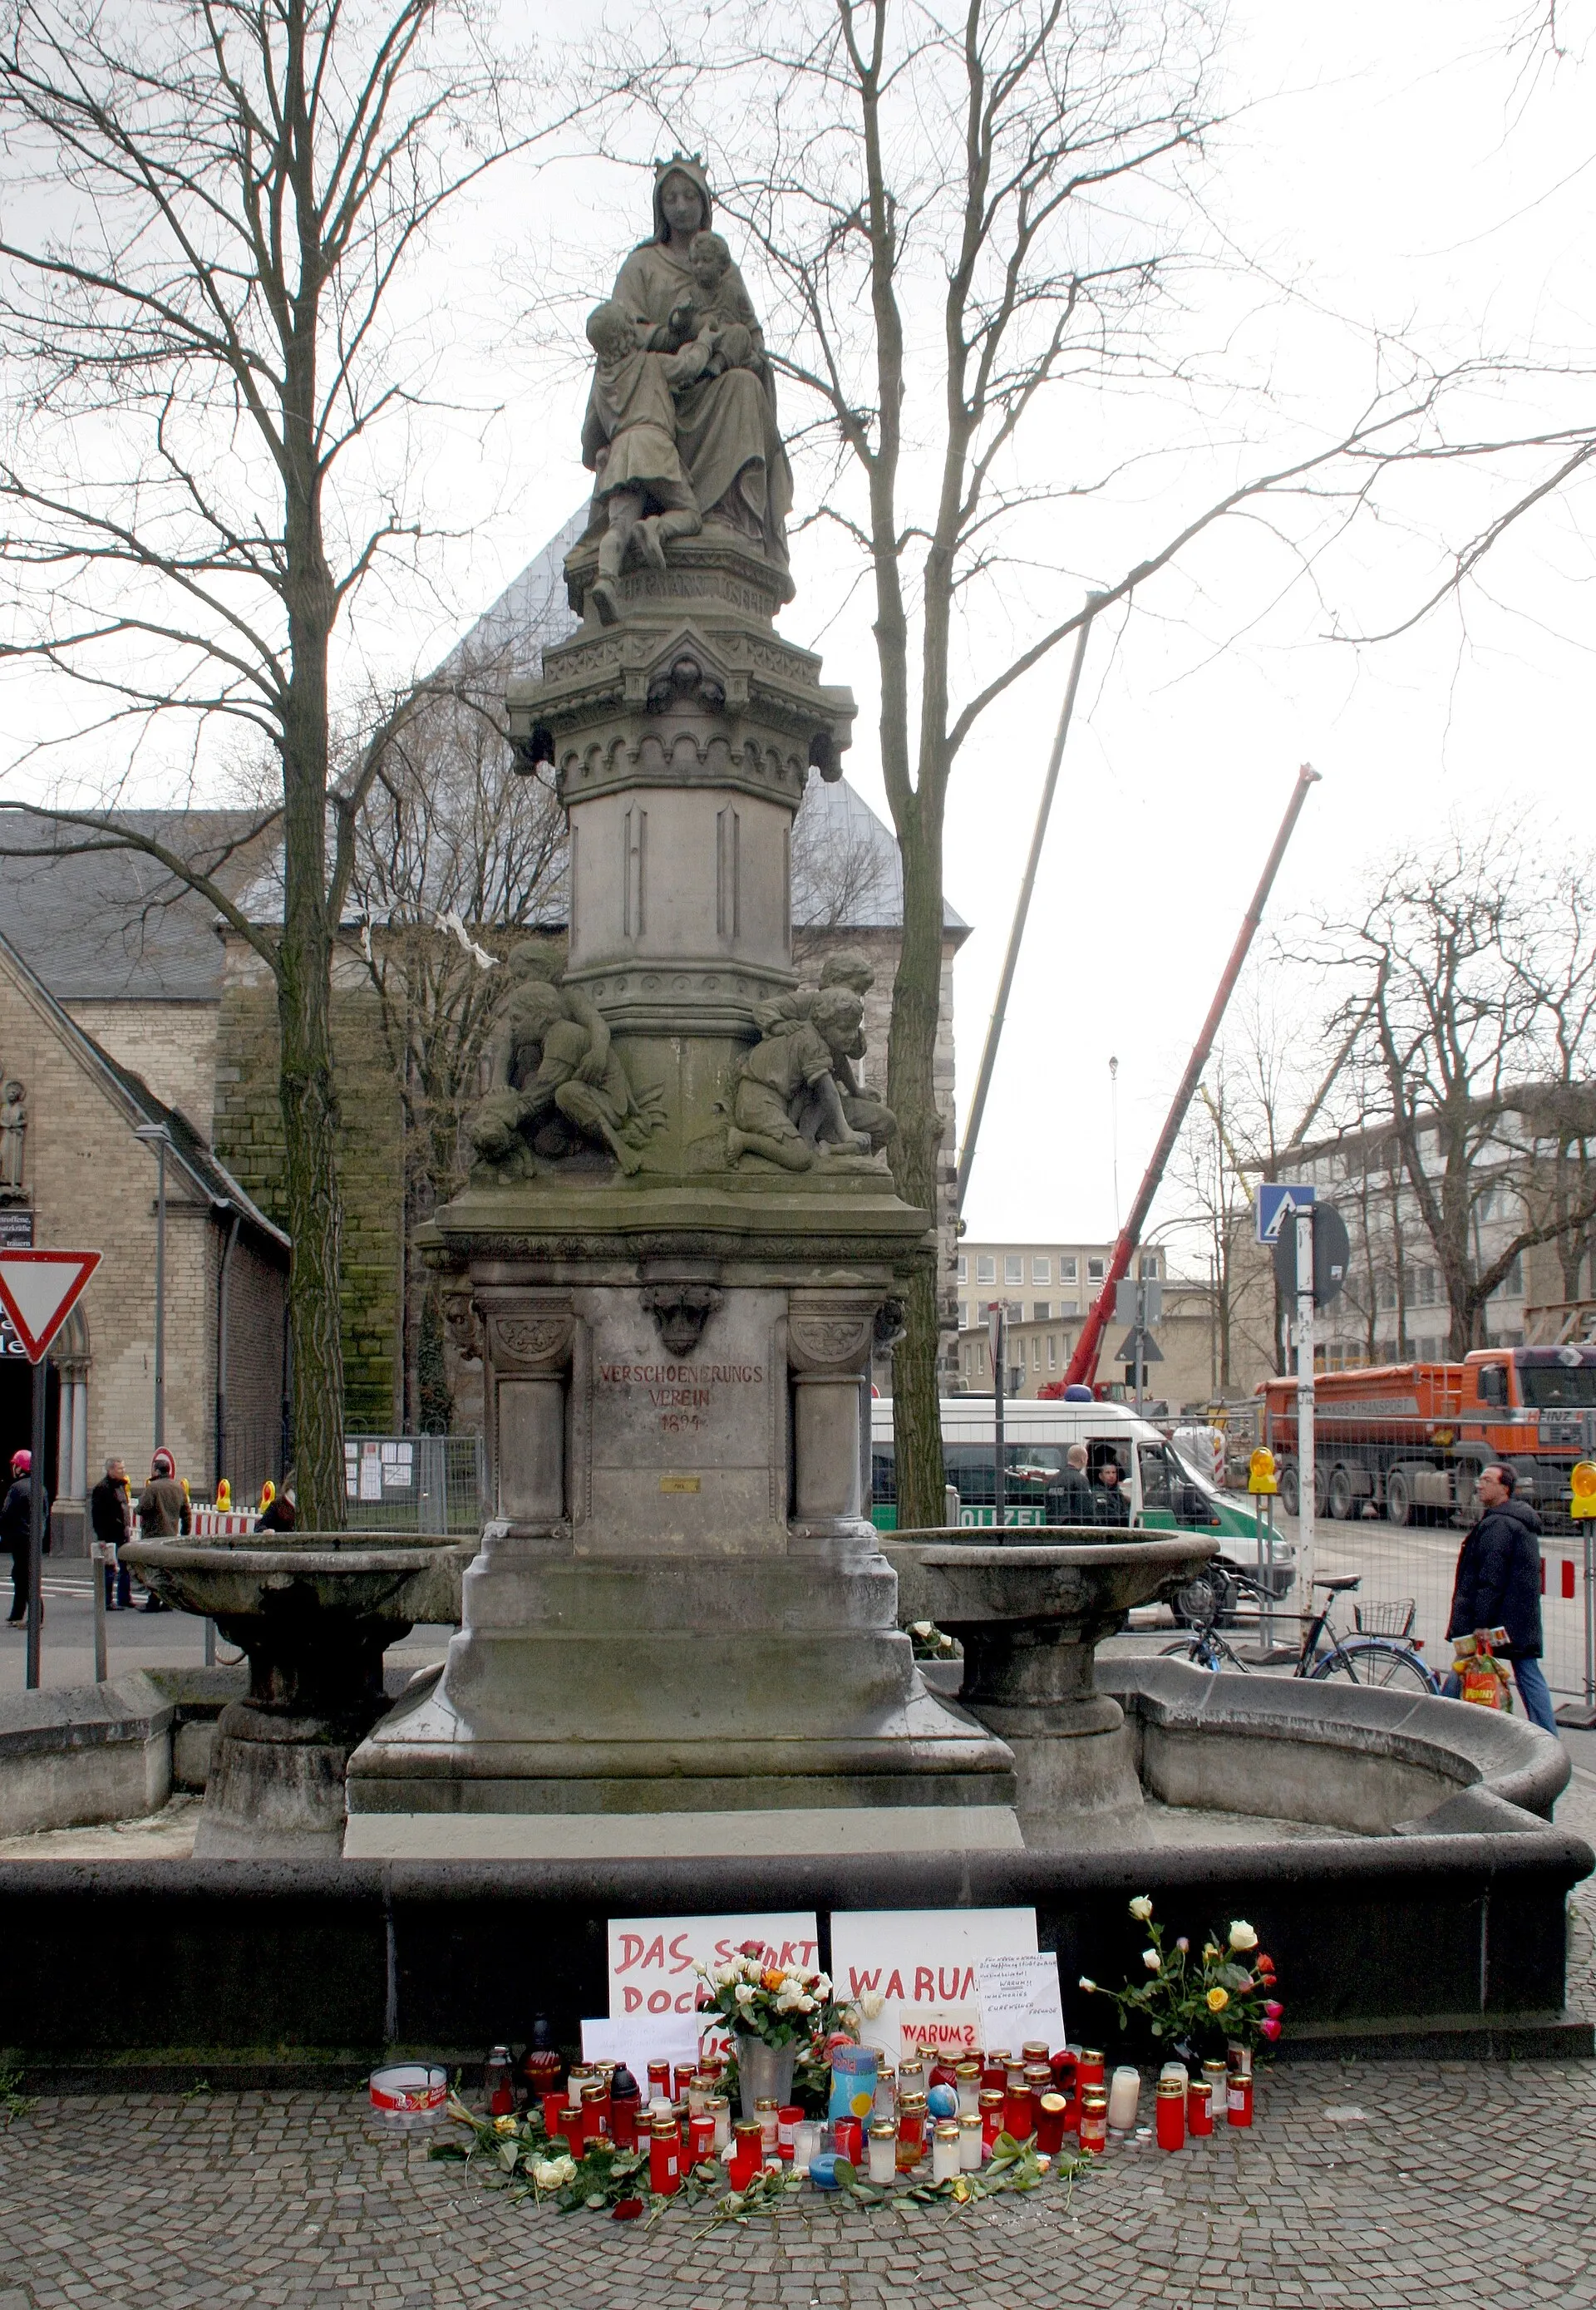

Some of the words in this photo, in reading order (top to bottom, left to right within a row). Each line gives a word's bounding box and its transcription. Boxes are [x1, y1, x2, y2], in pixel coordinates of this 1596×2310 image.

[1096, 1258, 1116, 1303] COLONIA
[600, 1365, 762, 1383] VERSCHOENERUNGS
[648, 1389, 710, 1406] VEREIN
[961, 1510, 1040, 1526] OLIZEI
[613, 1933, 693, 1974] DAS
[902, 2023, 975, 2046] WARUM?
